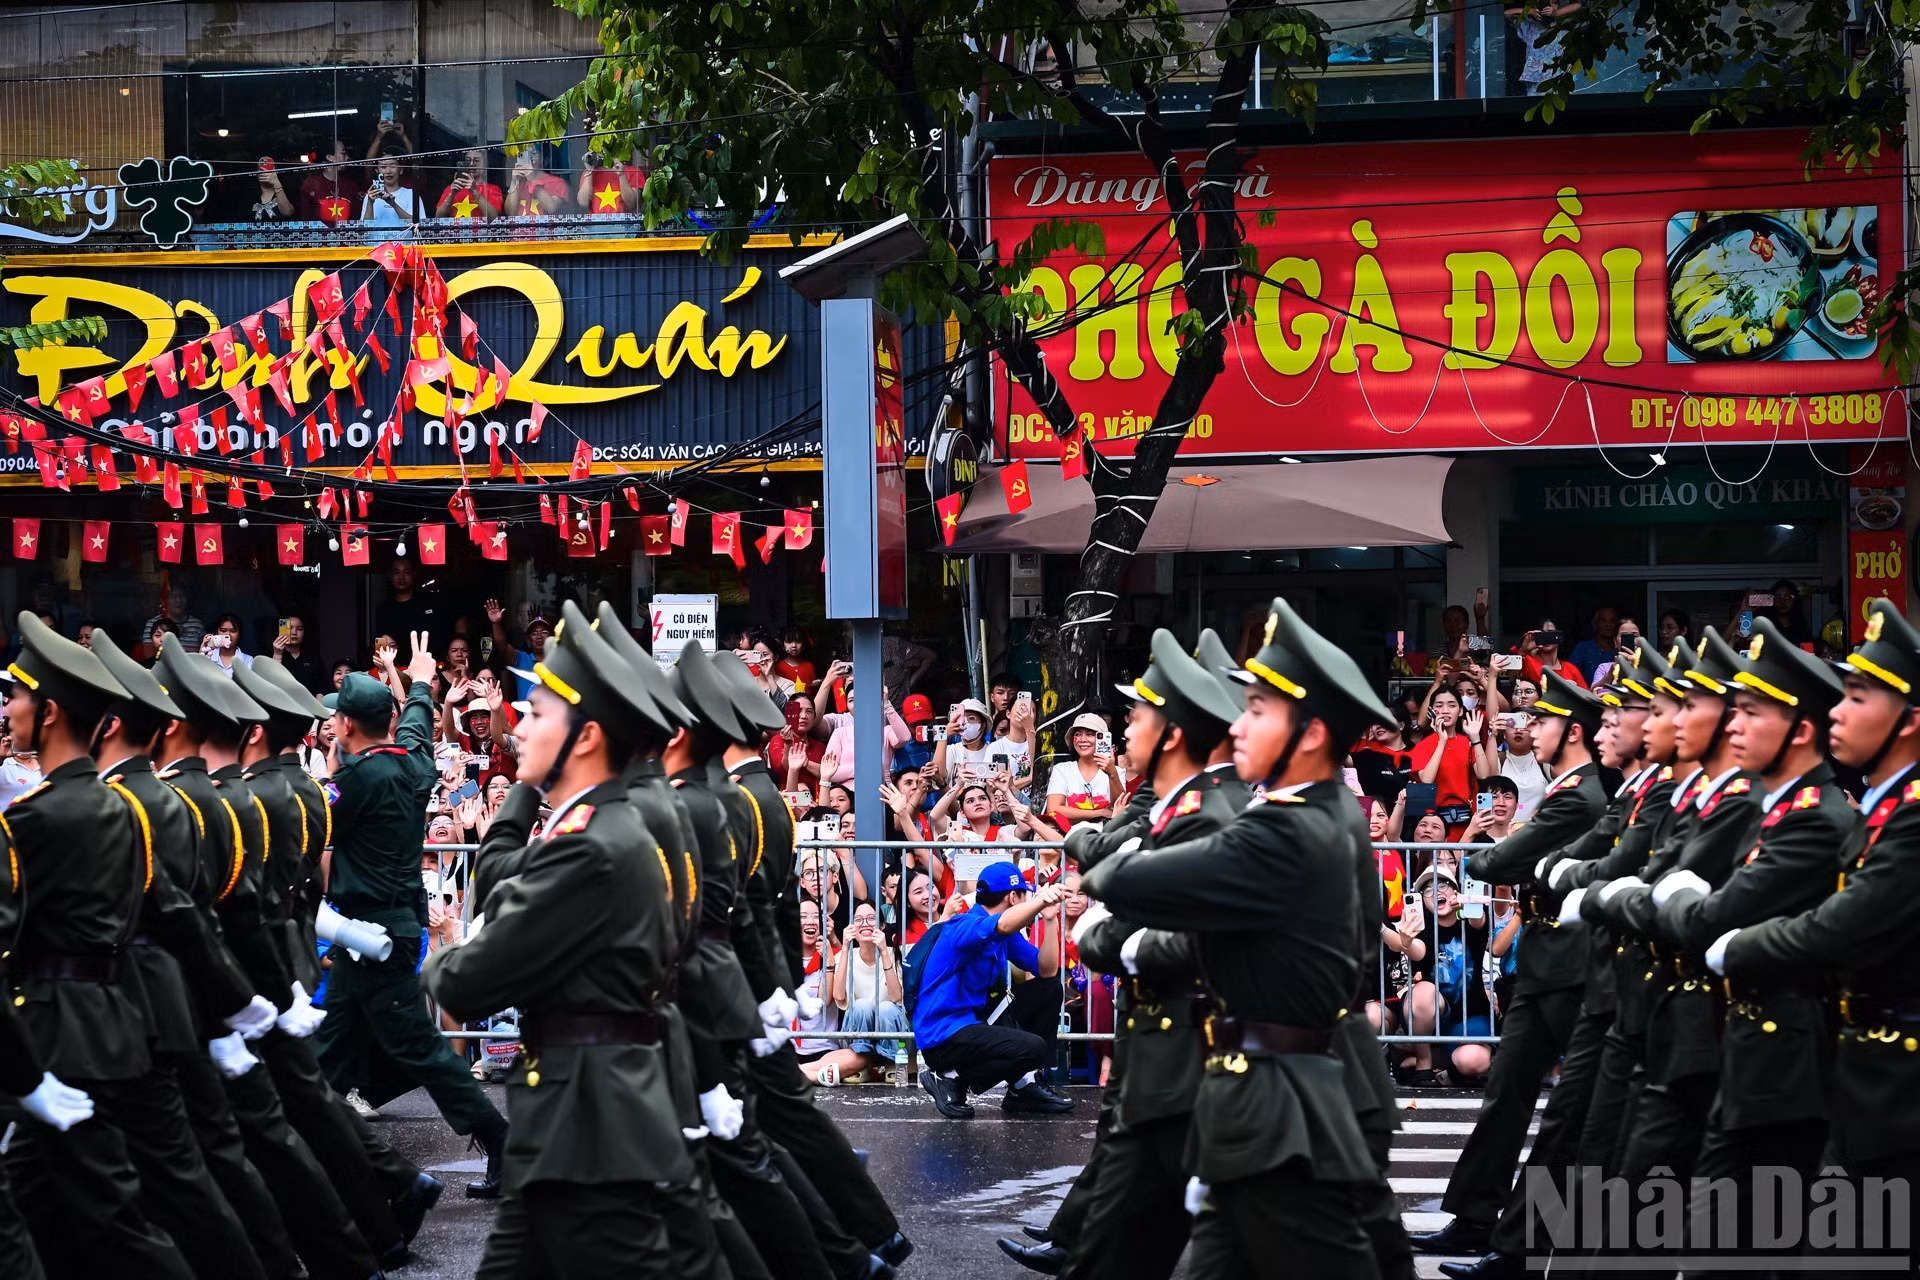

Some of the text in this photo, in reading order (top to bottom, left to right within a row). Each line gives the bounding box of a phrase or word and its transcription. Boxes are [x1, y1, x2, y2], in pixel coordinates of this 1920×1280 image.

[1014, 165, 1163, 212] Dũng
[1254, 219, 1413, 376] GÀ
[1444, 186, 1643, 369] ĐỒI
[411, 262, 788, 418] Quán
[1631, 393, 1882, 428] ĐT: 098 447 3808
[592, 446, 618, 461] ĐC:
[620, 442, 654, 460] SỐ41
[659, 443, 689, 460] VĂN
[1543, 479, 1613, 510] KÍNH
[1619, 476, 1698, 507] CHÀO
[1855, 540, 1902, 579] PHỞ
[666, 629, 690, 639] NGUY
